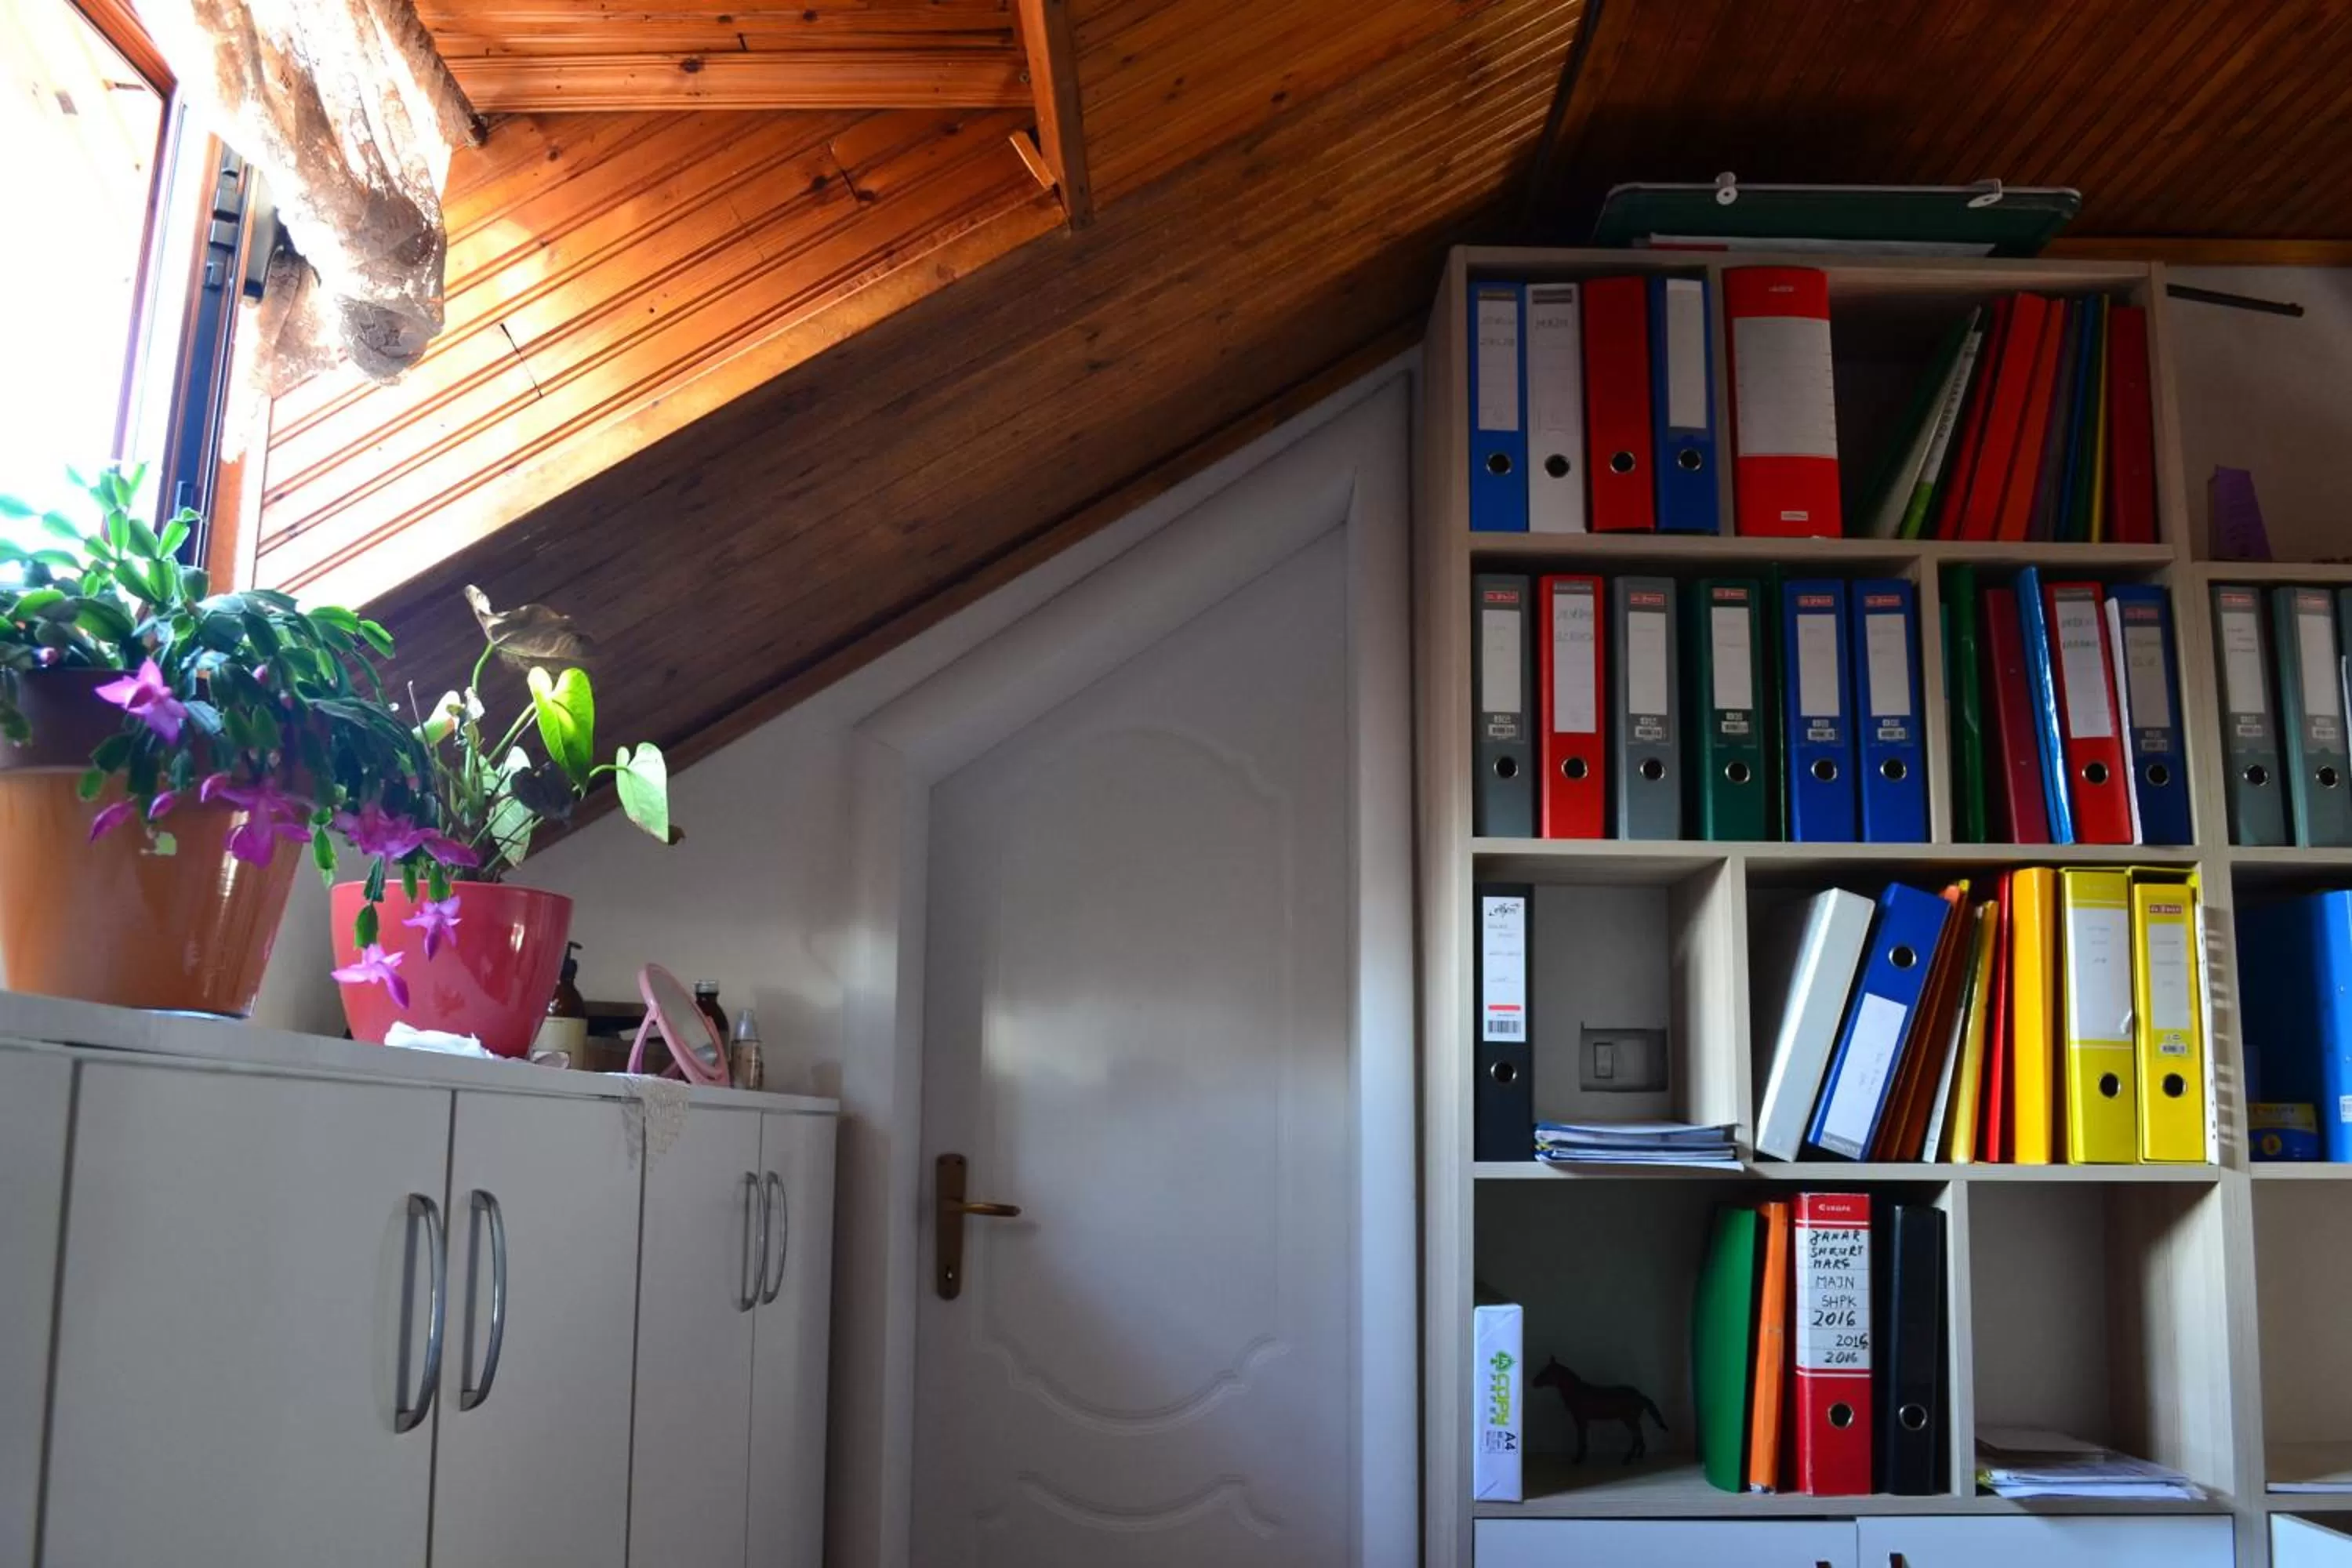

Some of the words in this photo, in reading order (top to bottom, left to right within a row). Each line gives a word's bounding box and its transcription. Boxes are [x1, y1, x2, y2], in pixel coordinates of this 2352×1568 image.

[1822, 1295, 1857, 1307] SHPK
[1813, 1310, 1856, 1326] 2016
[1824, 1352, 1858, 1363] 2016
[1504, 1431, 1516, 1450] A4
